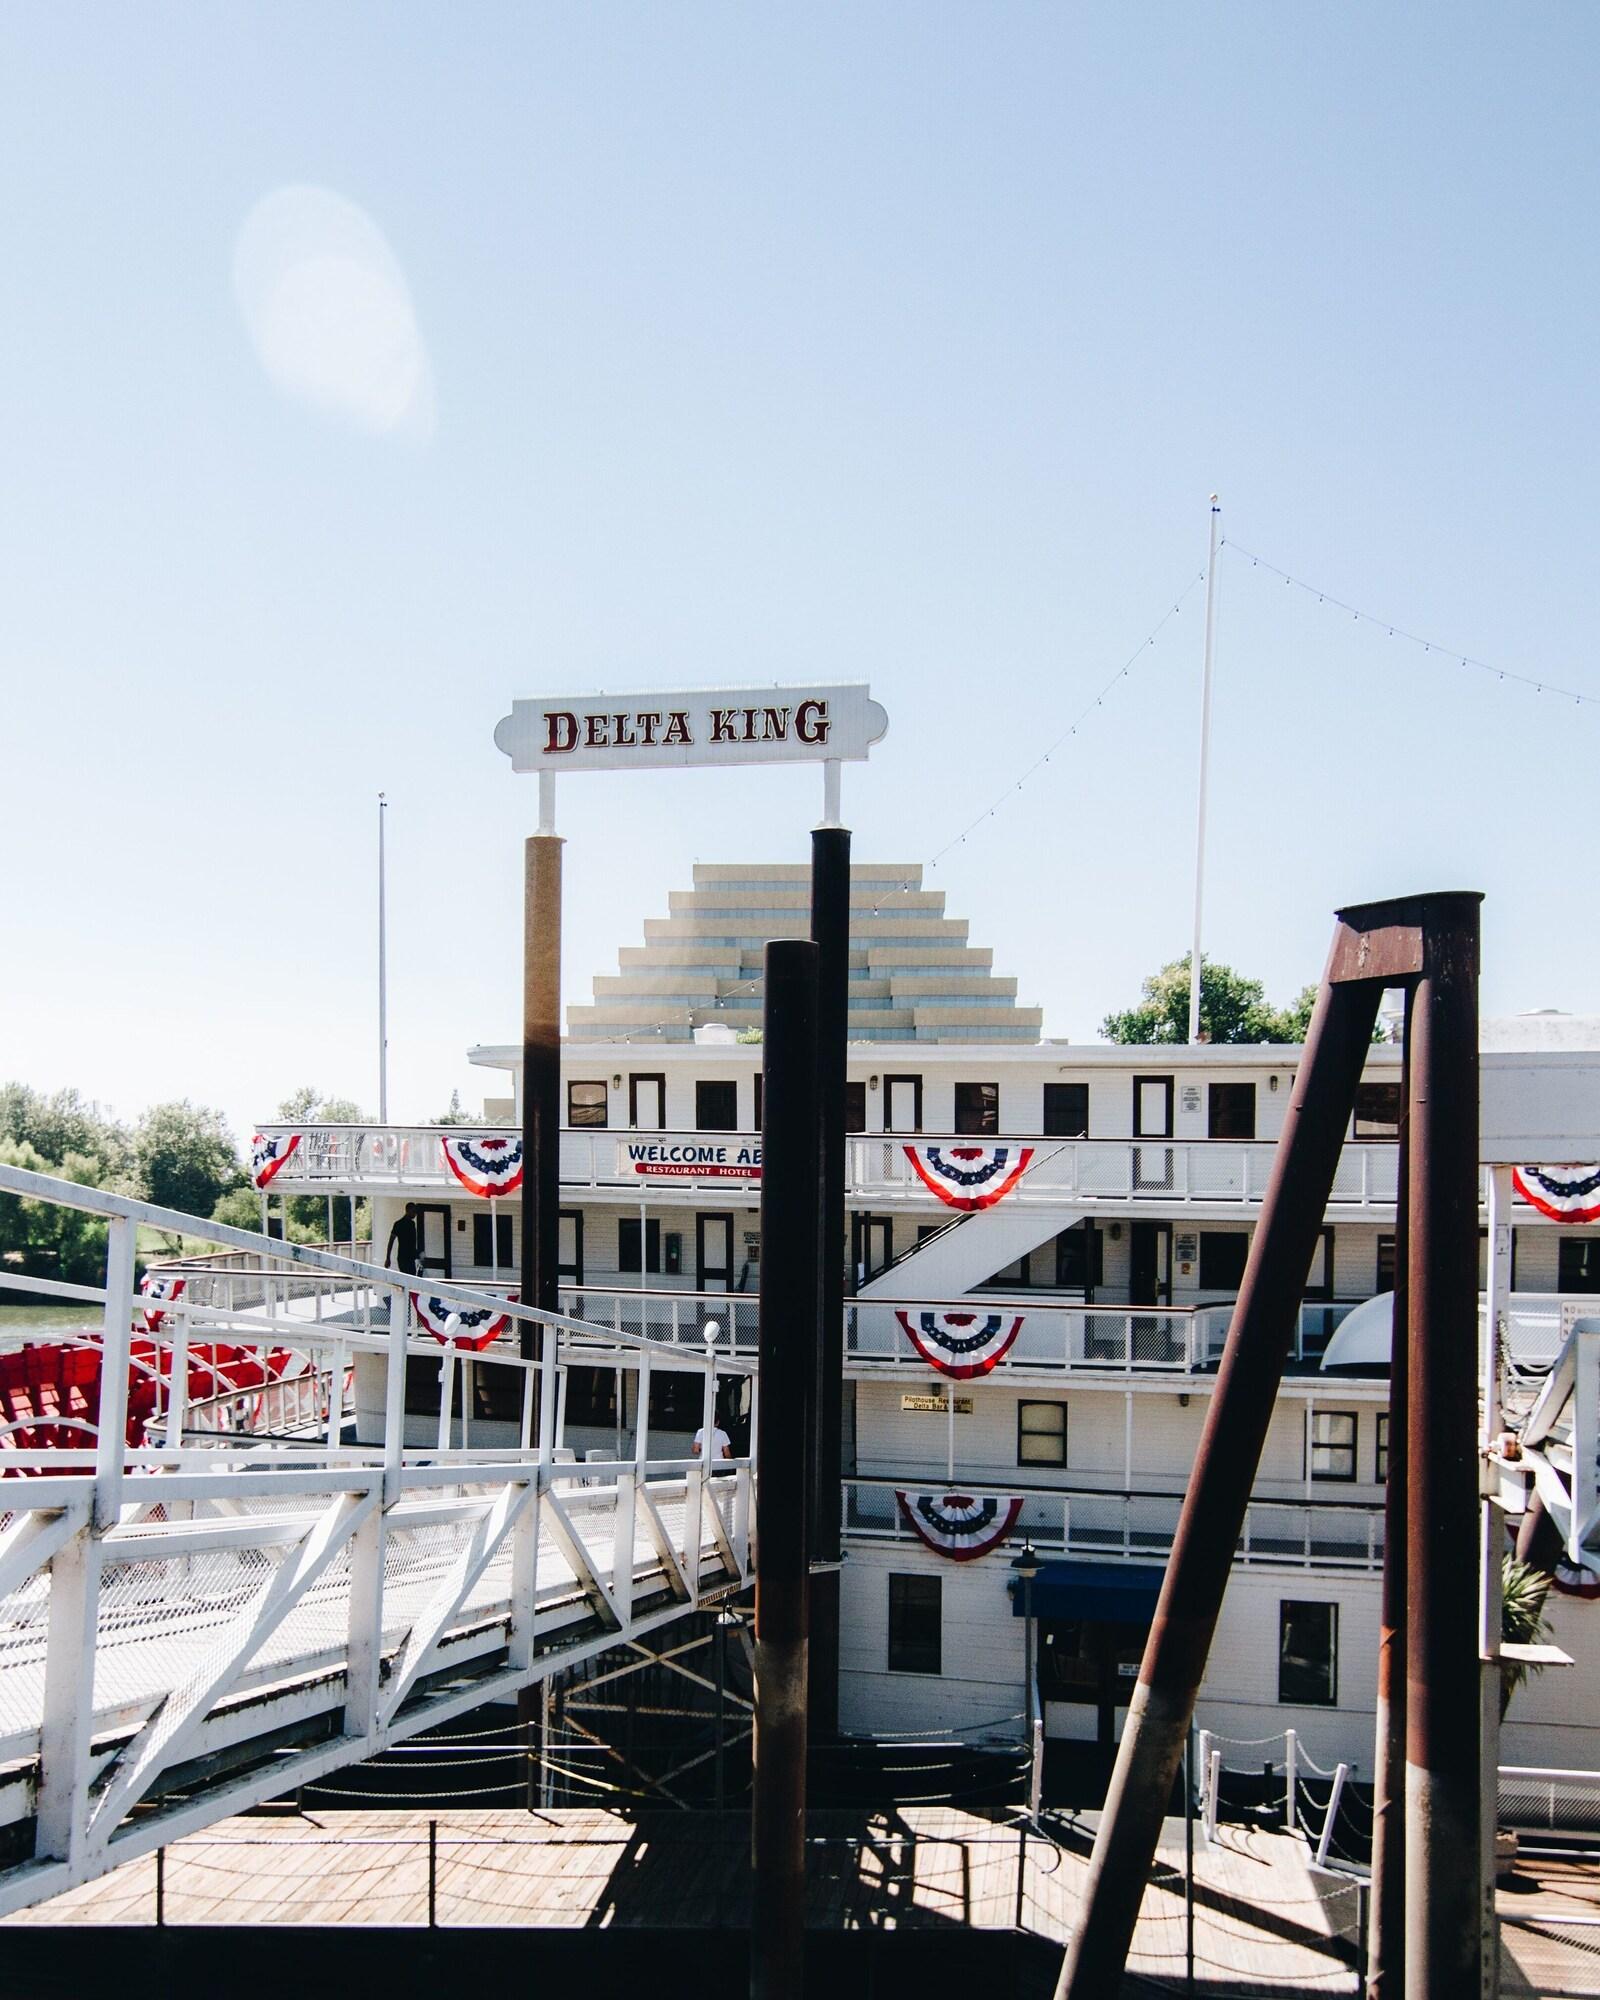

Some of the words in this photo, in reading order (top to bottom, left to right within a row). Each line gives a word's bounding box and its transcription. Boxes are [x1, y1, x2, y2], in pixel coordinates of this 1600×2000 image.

[542, 711, 694, 754] DELTA
[708, 699, 832, 746] KING
[628, 1144, 727, 1163] WELCOME
[646, 1165, 712, 1176] RESTAURANT
[719, 1168, 753, 1178] HOTEL
